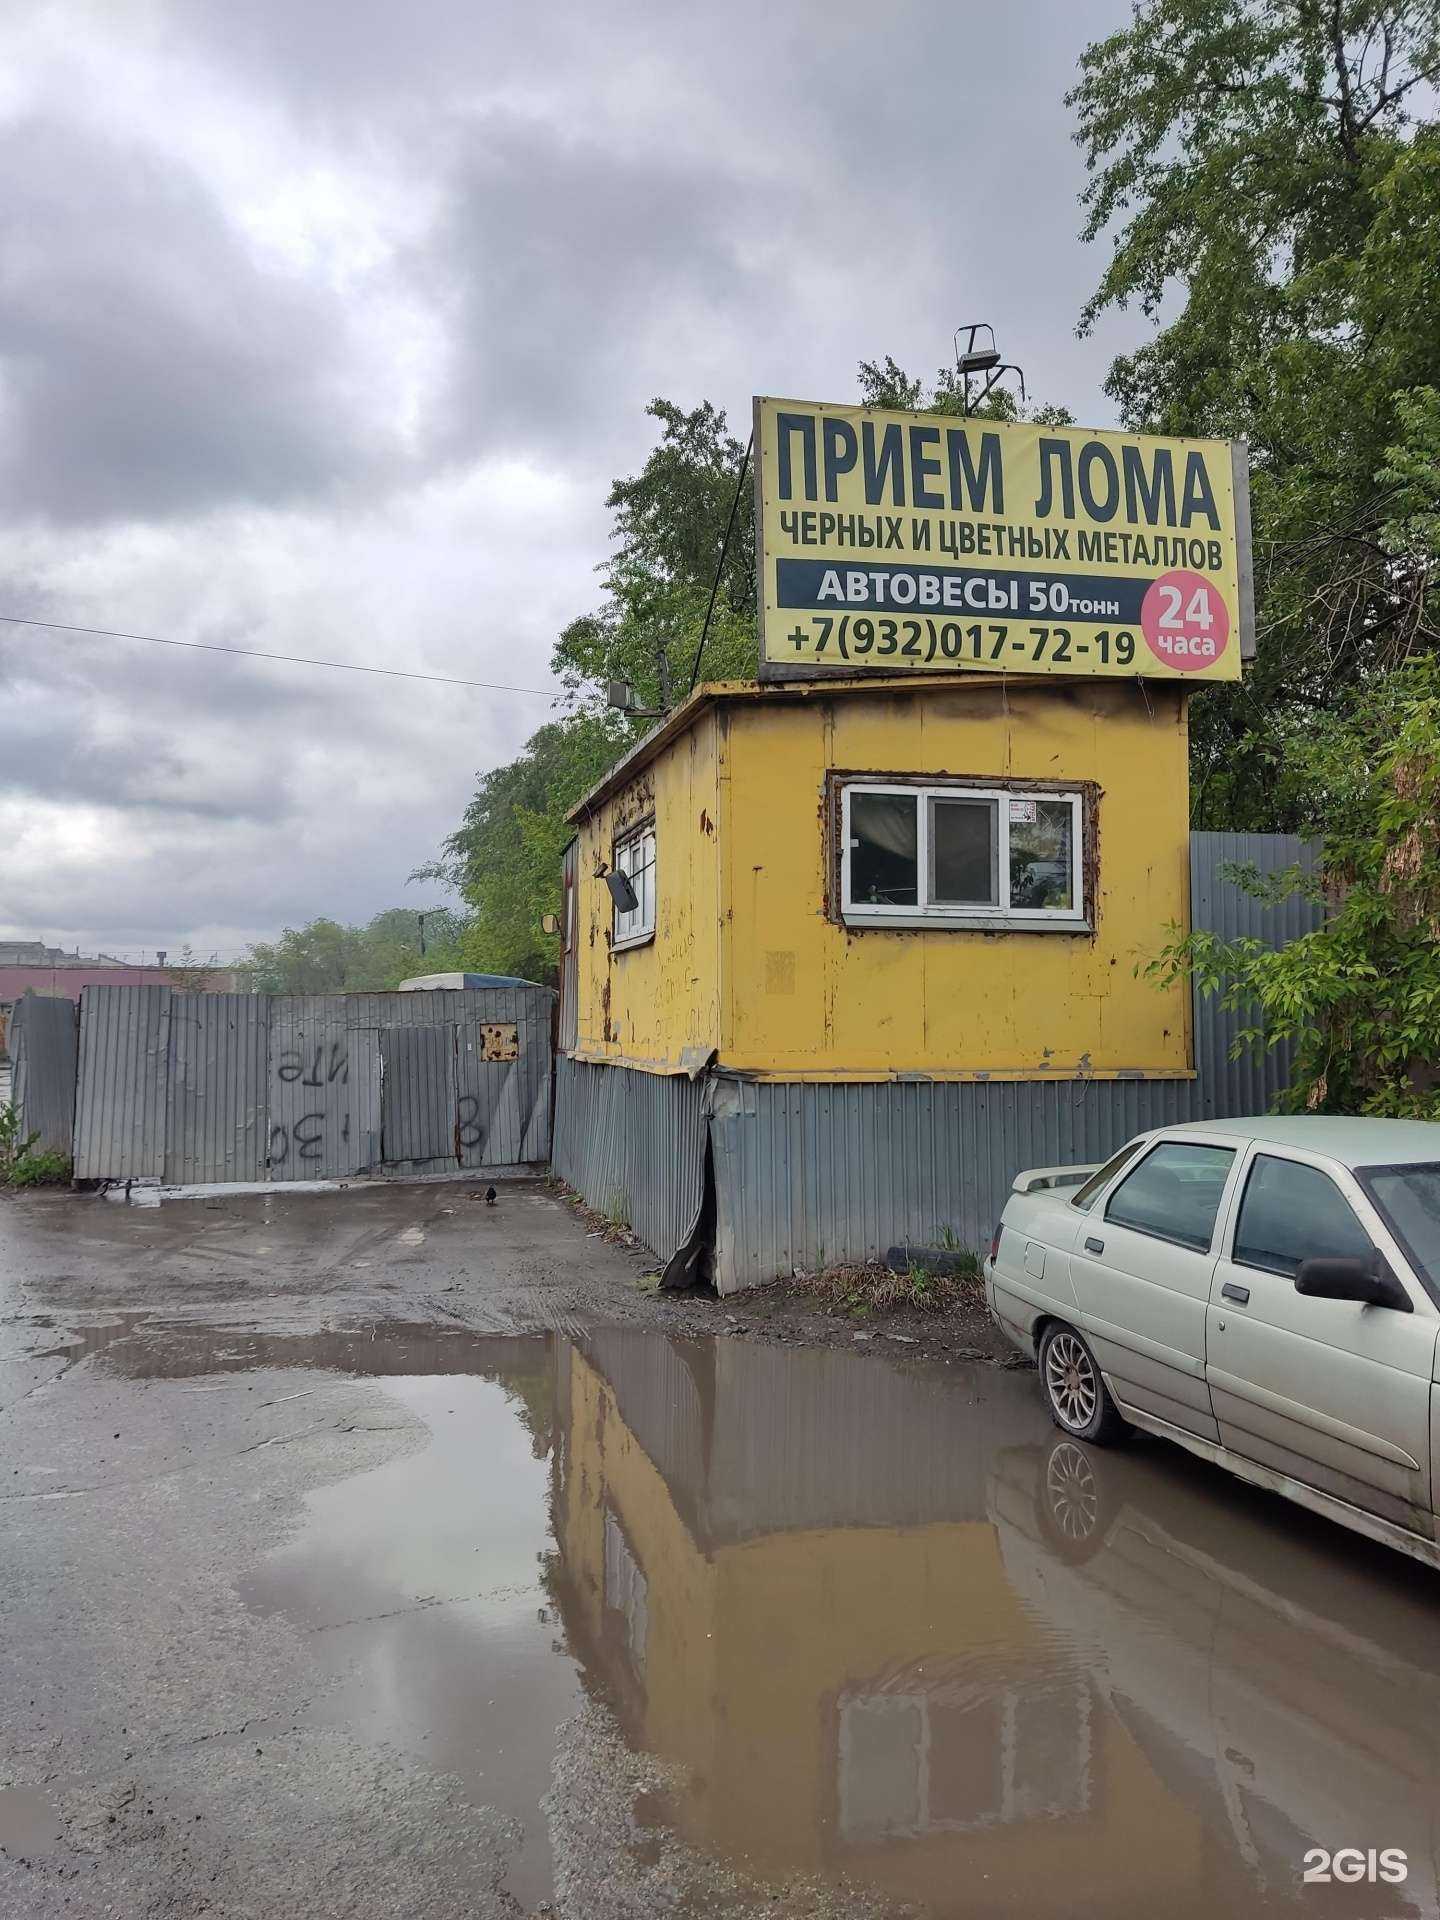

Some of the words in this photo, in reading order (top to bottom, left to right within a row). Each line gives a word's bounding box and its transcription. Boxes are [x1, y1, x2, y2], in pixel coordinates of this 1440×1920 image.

[777, 413, 1004, 514] ПРИЕМ
[1035, 438, 1221, 531] ЛОМА
[780, 511, 904, 550] ЧЕРНЫХ
[912, 518, 931, 551] И
[939, 520, 1071, 560] ЦВЕТНЫХ
[1077, 530, 1223, 571] МЕТАЛЛОВ
[817, 570, 1018, 610] АВТОВЕСЫ
[1158, 586, 1213, 630] 24
[787, 615, 1136, 665] +7(932)017-72-19
[1158, 635, 1216, 656] часа
